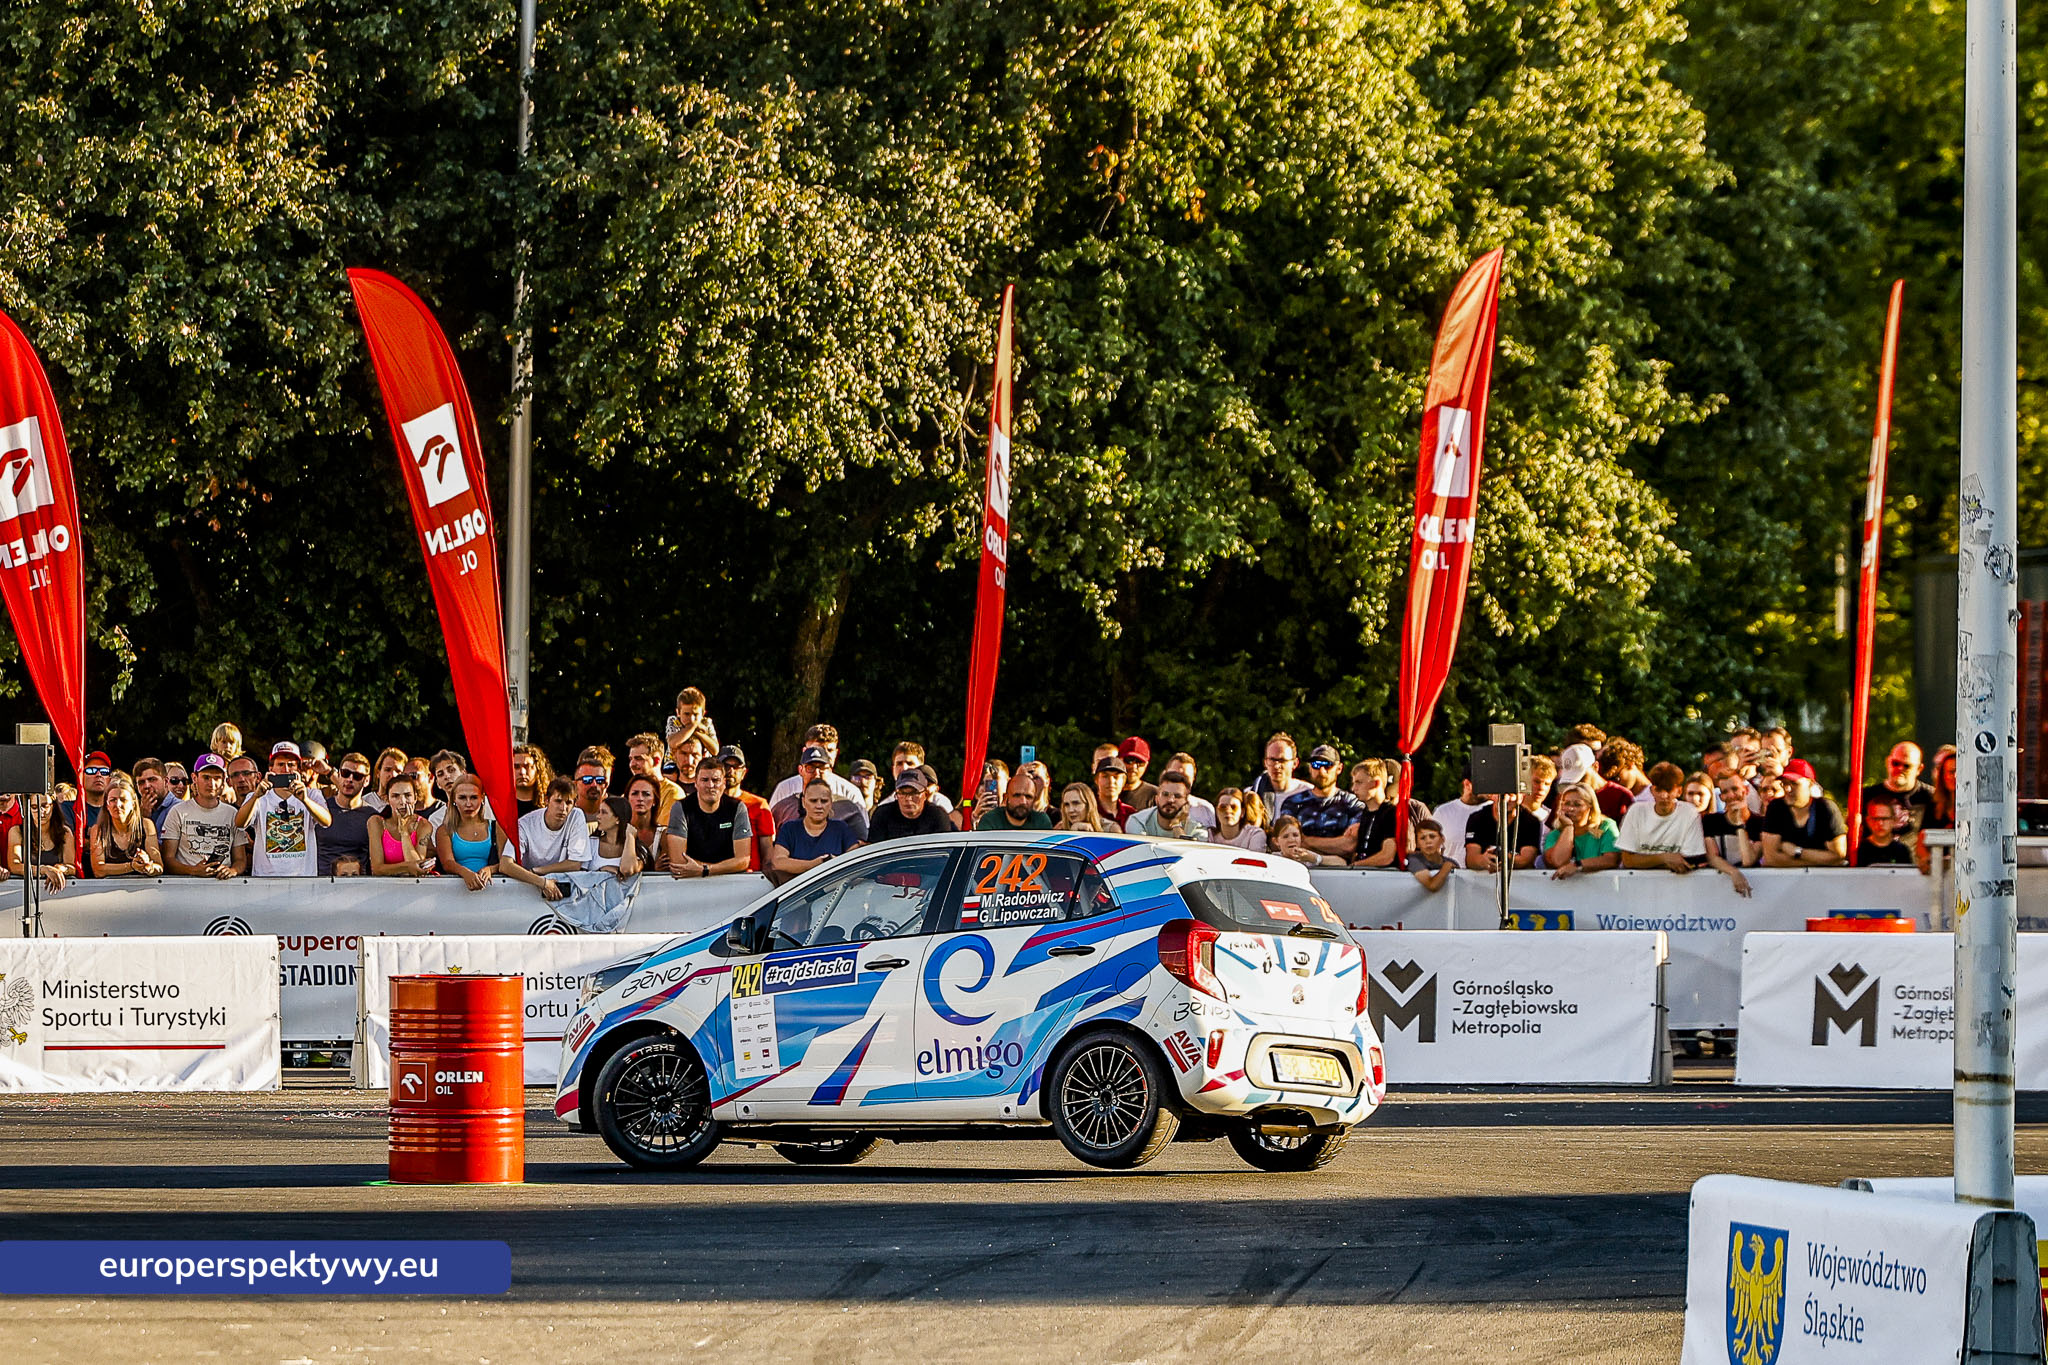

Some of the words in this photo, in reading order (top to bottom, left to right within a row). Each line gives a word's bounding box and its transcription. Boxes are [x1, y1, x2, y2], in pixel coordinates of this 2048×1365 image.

[975, 853, 1048, 894] 242
[981, 890, 1065, 908] M.Radołowicz
[979, 907, 1059, 924] G.Lipowczan
[732, 963, 761, 998] 242
[765, 956, 855, 986] #rajdslaska
[42, 980, 180, 999] Ministerstwo
[1452, 980, 1553, 998] Górnośląsko
[42, 1007, 112, 1030] Sportu
[119, 1007, 124, 1026] i
[131, 1007, 226, 1030] Turystyki
[1452, 1019, 1541, 1038] Metropolia
[917, 1036, 1024, 1079] elmigo
[434, 1071, 484, 1084] ORLEN
[435, 1085, 454, 1096] OIL
[1807, 1241, 1927, 1295] Województwo
[1803, 1292, 1865, 1347] Śląskie
